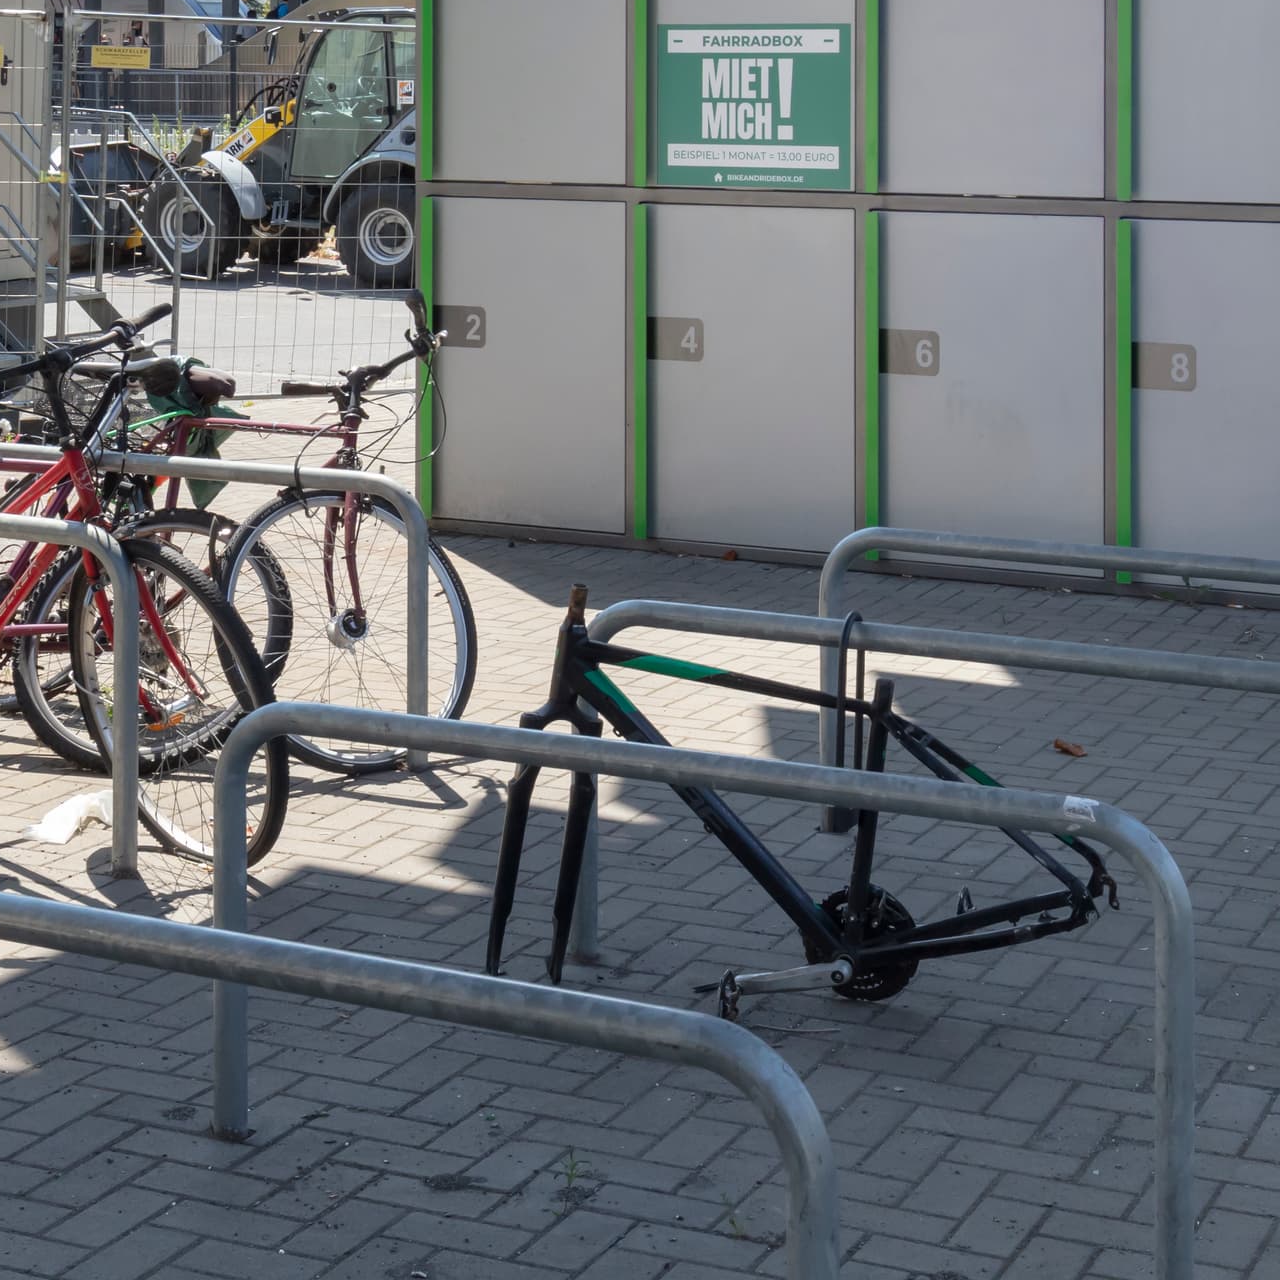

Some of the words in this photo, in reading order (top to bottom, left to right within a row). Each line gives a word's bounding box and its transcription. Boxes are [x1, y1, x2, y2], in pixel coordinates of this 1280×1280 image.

[702, 35, 803, 47] FAHRRADBOX
[702, 58, 773, 99] MIET
[673, 150, 720, 160] BEISPIEL:
[728, 151, 766, 161] MONAT
[777, 152, 802, 163] 13,00
[805, 153, 835, 162] EURO
[727, 174, 804, 183] BIKEANDRIDEBOX.DE
[466, 313, 481, 341] 2
[680, 326, 697, 353] 4
[915, 339, 933, 368] 6
[1171, 352, 1190, 382] 8
